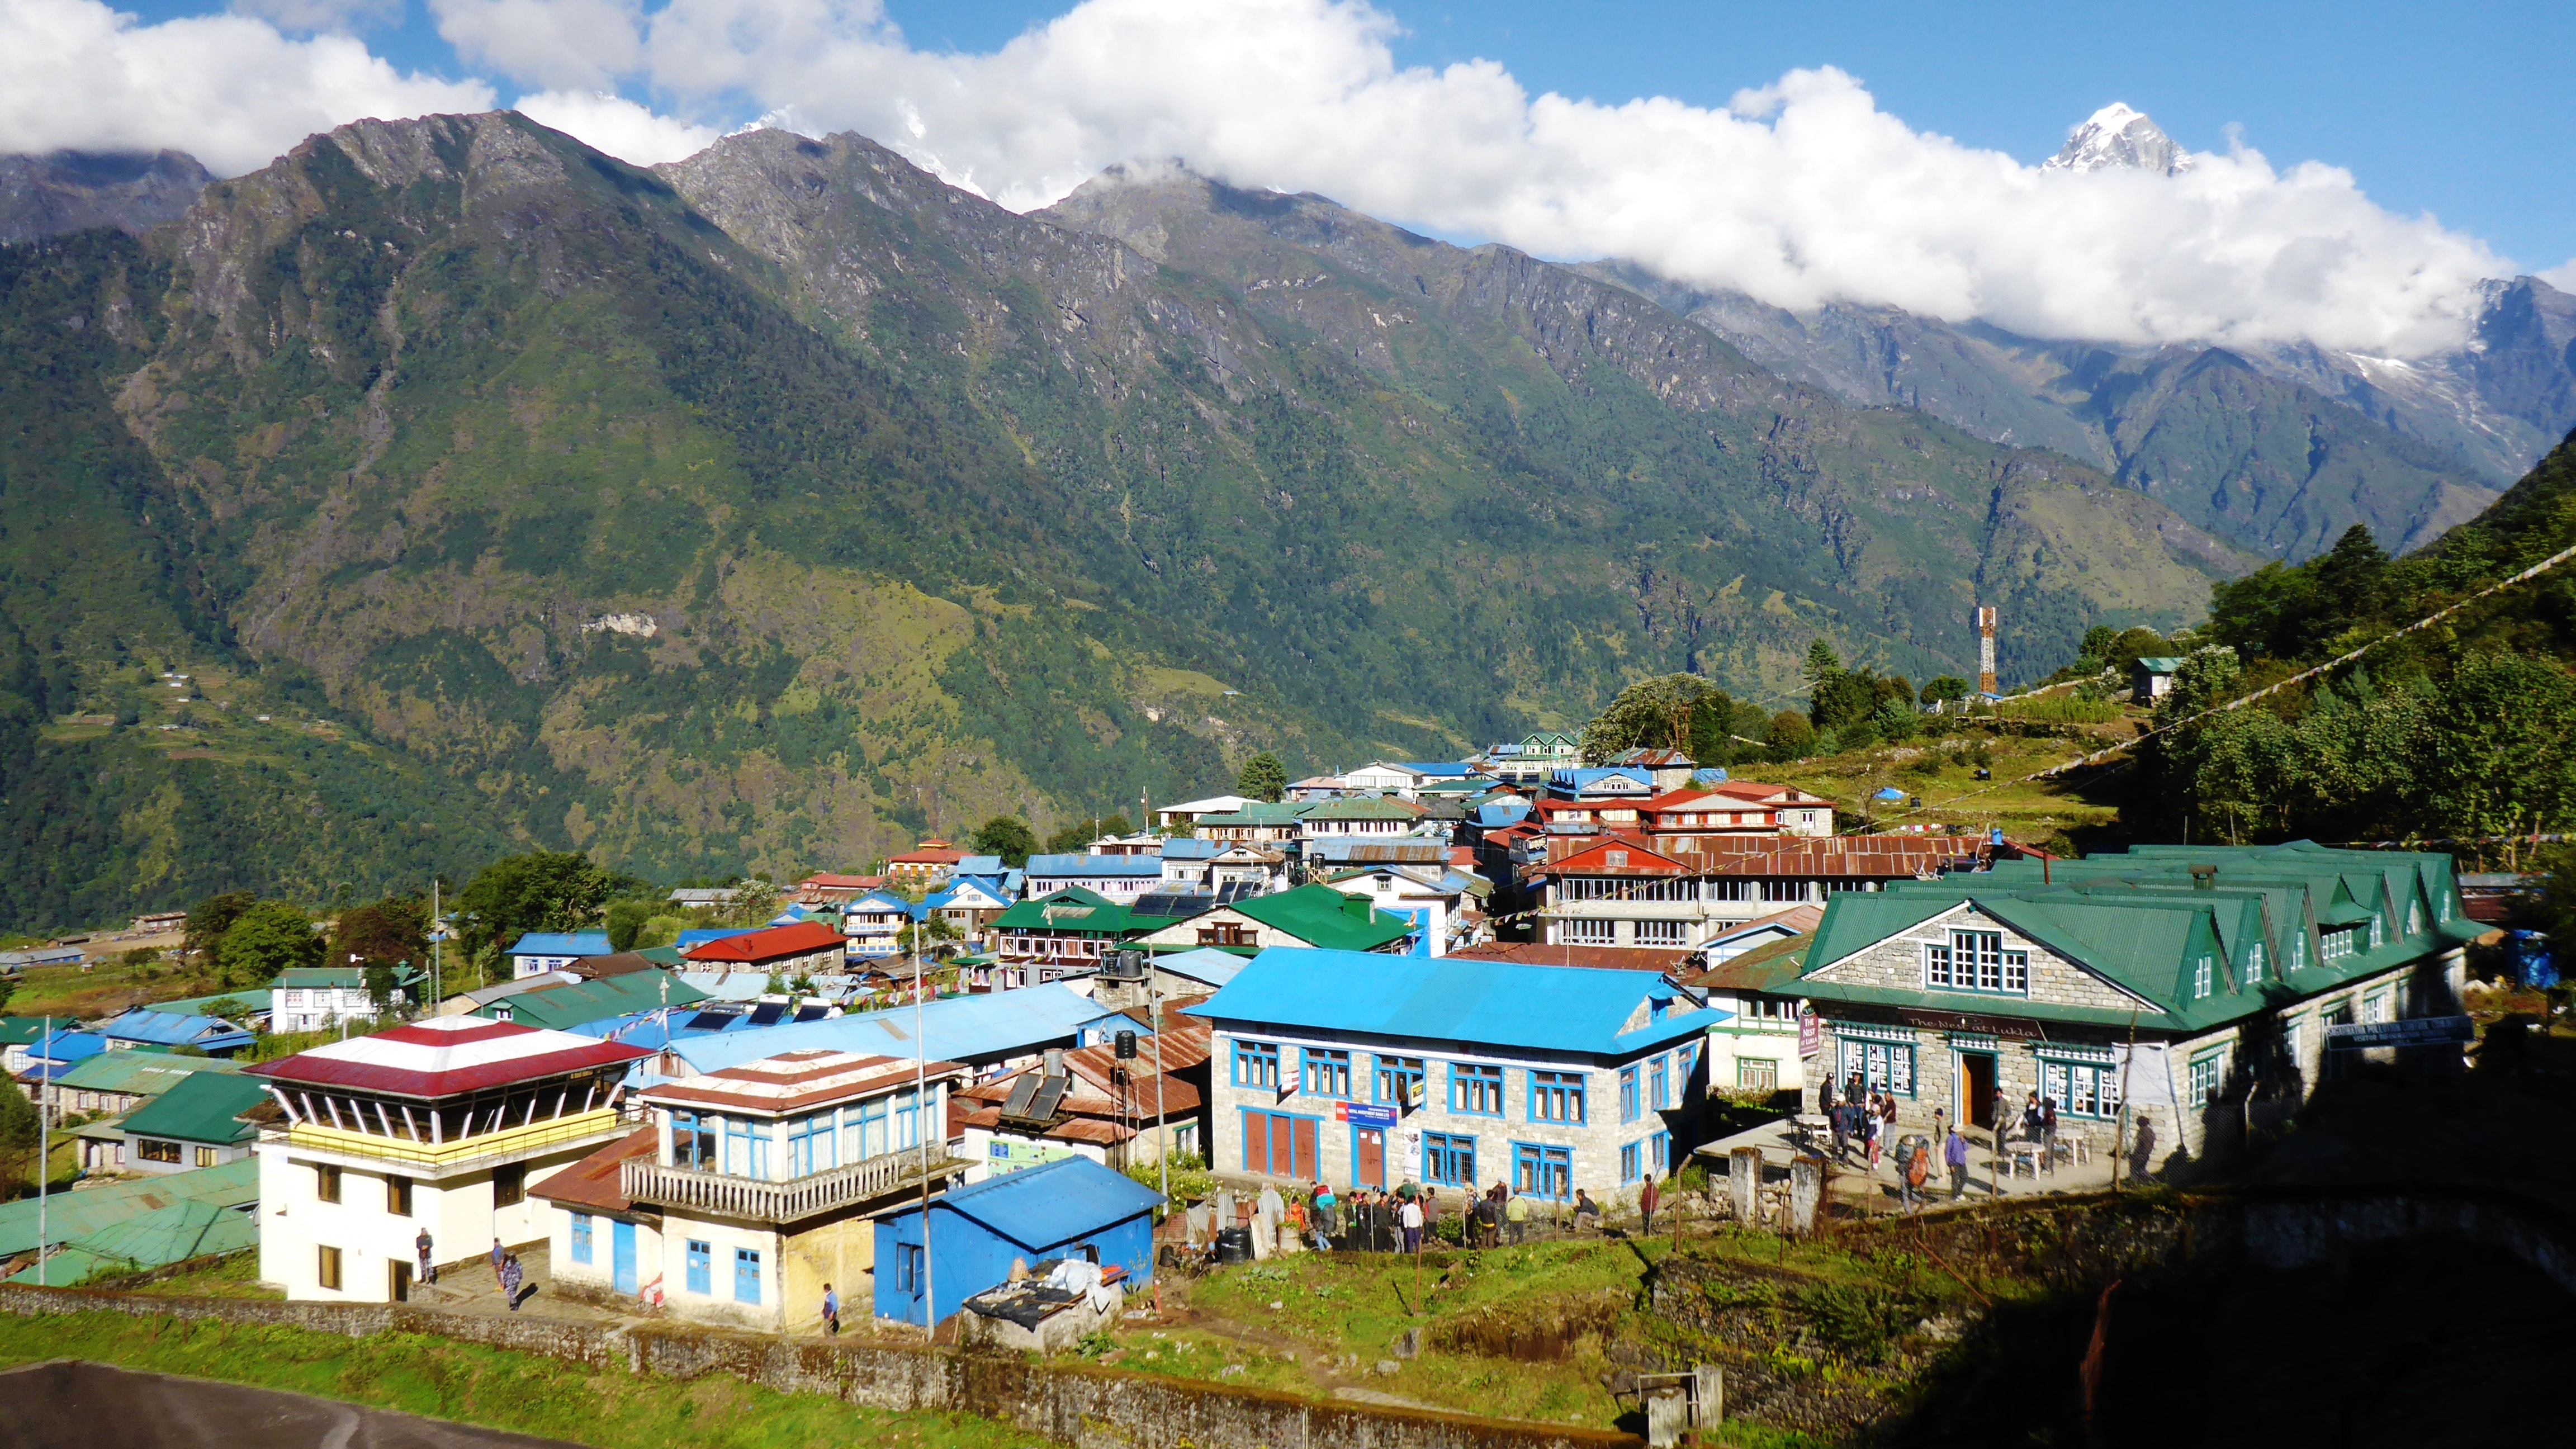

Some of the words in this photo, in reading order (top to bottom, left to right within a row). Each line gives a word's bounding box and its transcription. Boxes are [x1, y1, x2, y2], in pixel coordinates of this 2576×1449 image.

[1805, 1018, 1814, 1027] THE
[1909, 1018, 1936, 1026] The
[1938, 1020, 1969, 1030] Nest
[1992, 1026, 2037, 1037] Lukla
[1803, 1028, 1815, 1038] NEST
